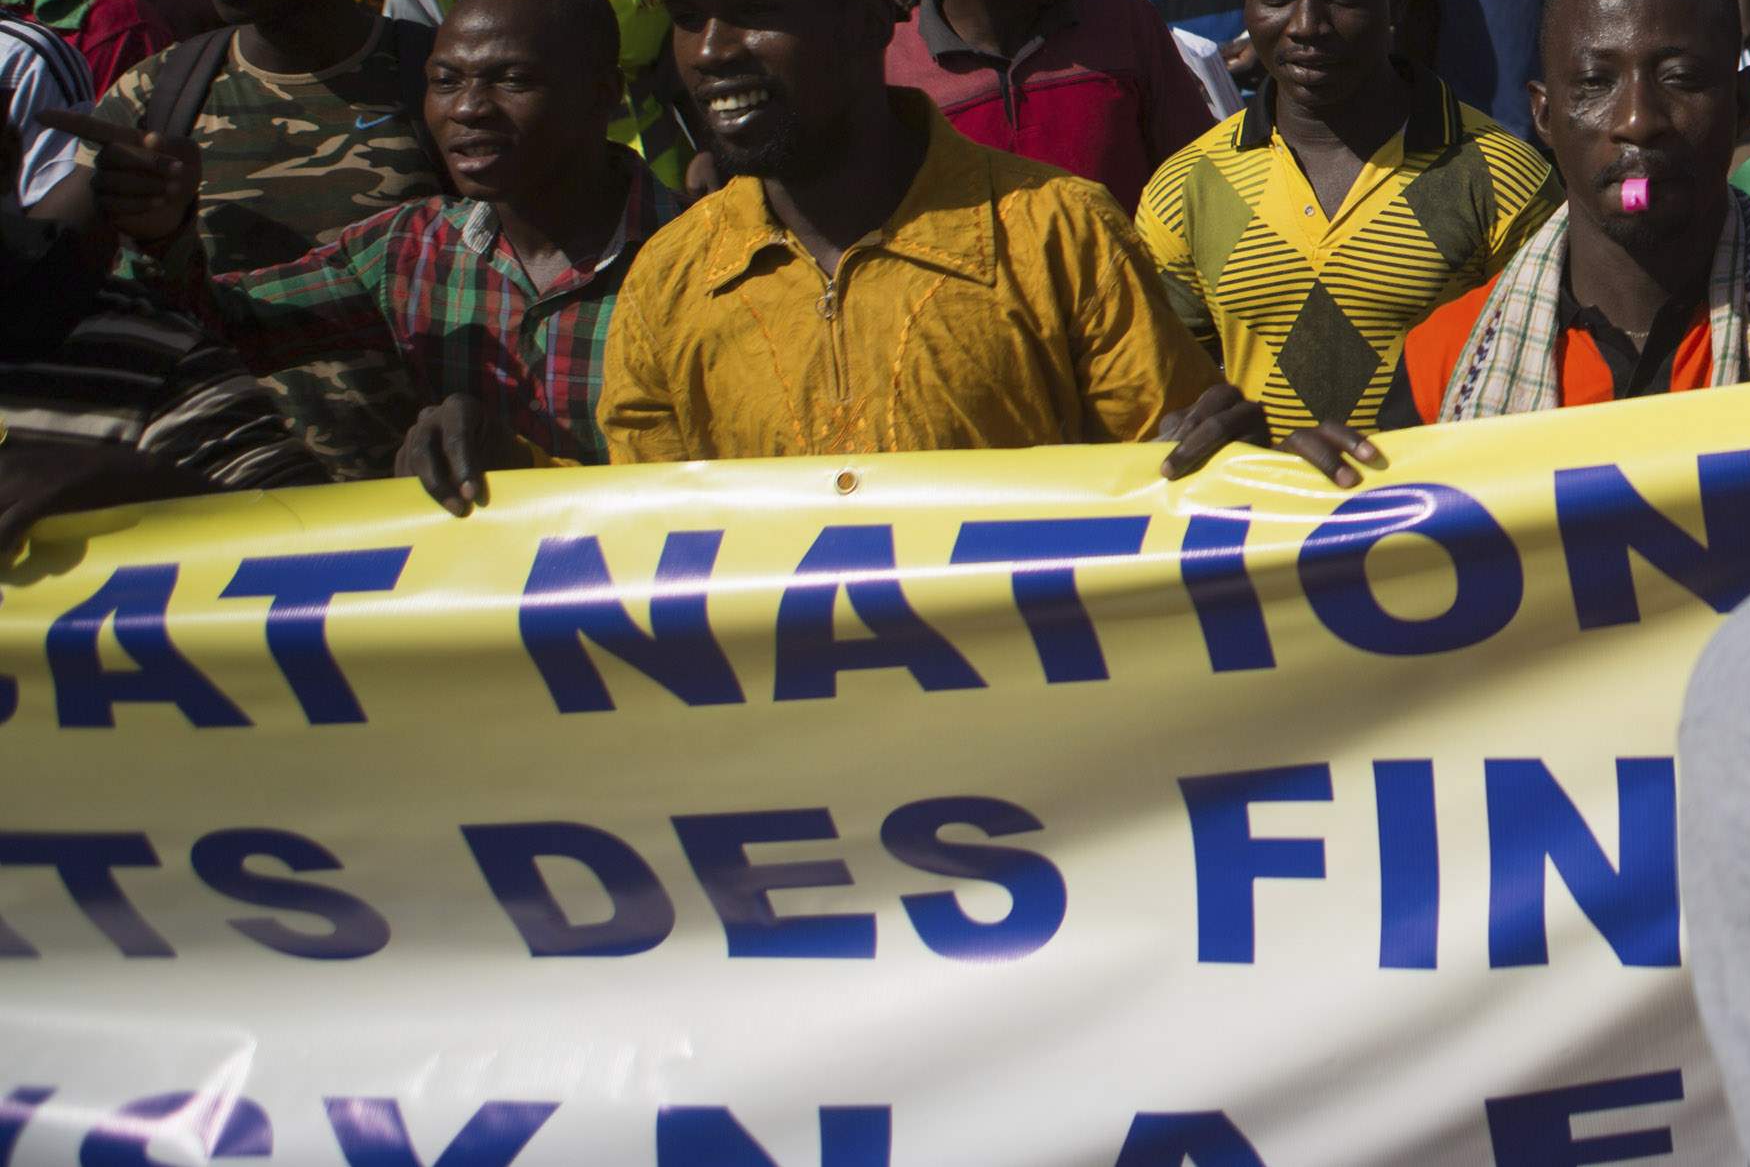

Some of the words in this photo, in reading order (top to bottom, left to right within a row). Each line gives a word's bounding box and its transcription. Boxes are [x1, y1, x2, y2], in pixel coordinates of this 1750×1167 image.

[0, 546, 412, 729] AT
[0, 828, 391, 961] TS
[459, 795, 1067, 965] DES
